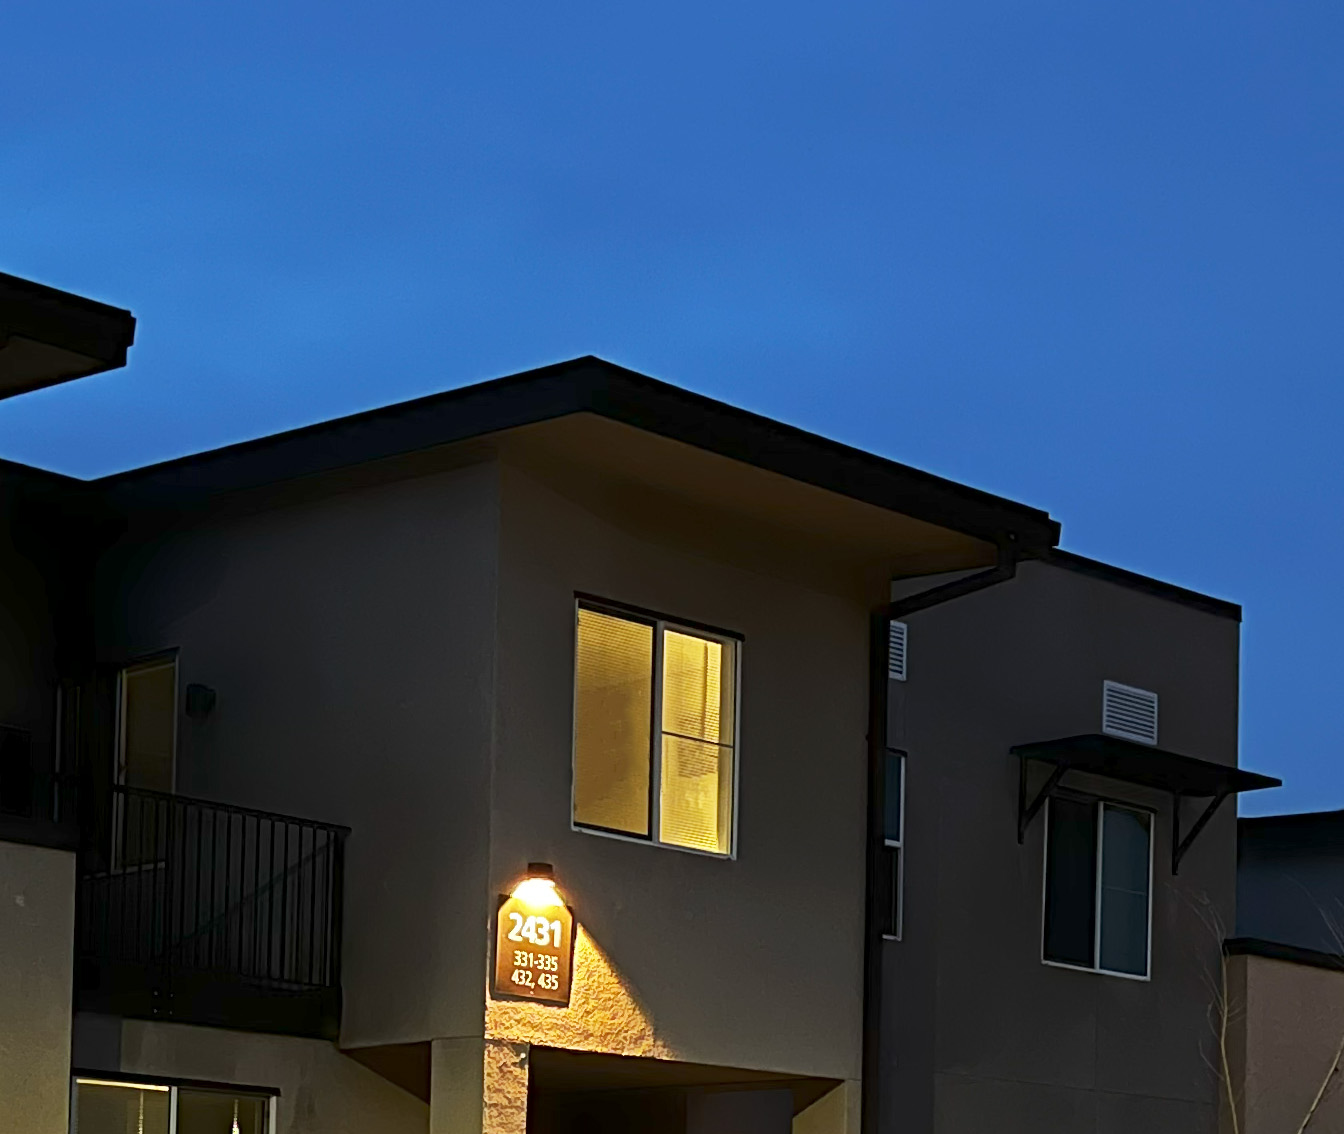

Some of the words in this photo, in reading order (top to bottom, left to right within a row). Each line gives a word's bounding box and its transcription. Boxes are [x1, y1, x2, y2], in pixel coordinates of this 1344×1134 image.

[508, 912, 562, 948] 2431
[513, 950, 559, 972] 331-335
[511, 969, 535, 989] 432,
[537, 973, 559, 990] 435
